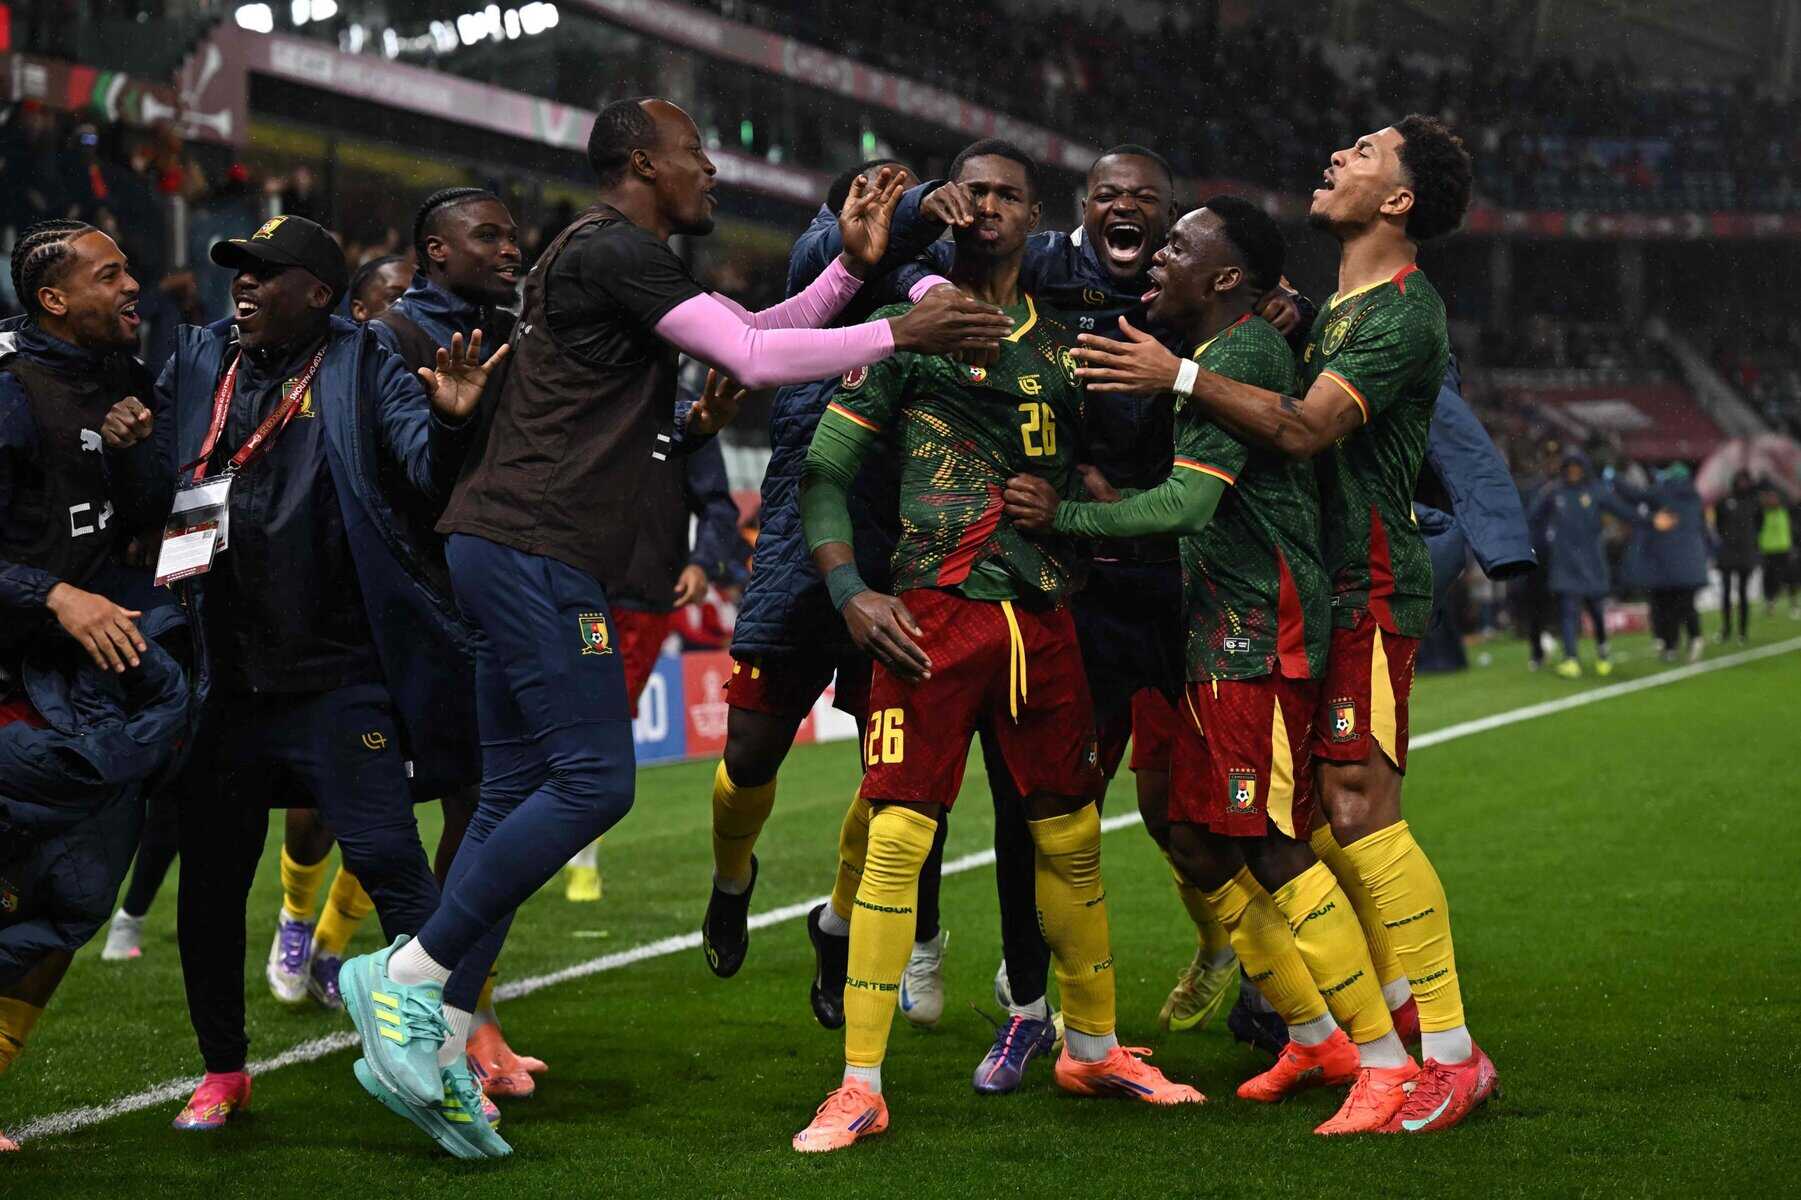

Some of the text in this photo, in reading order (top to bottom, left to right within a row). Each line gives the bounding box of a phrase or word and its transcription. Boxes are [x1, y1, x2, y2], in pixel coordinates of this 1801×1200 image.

[1079, 316, 1095, 330] 23
[289, 374, 312, 401] NATIONS
[1018, 402, 1057, 457] 26
[868, 708, 904, 766] 26
